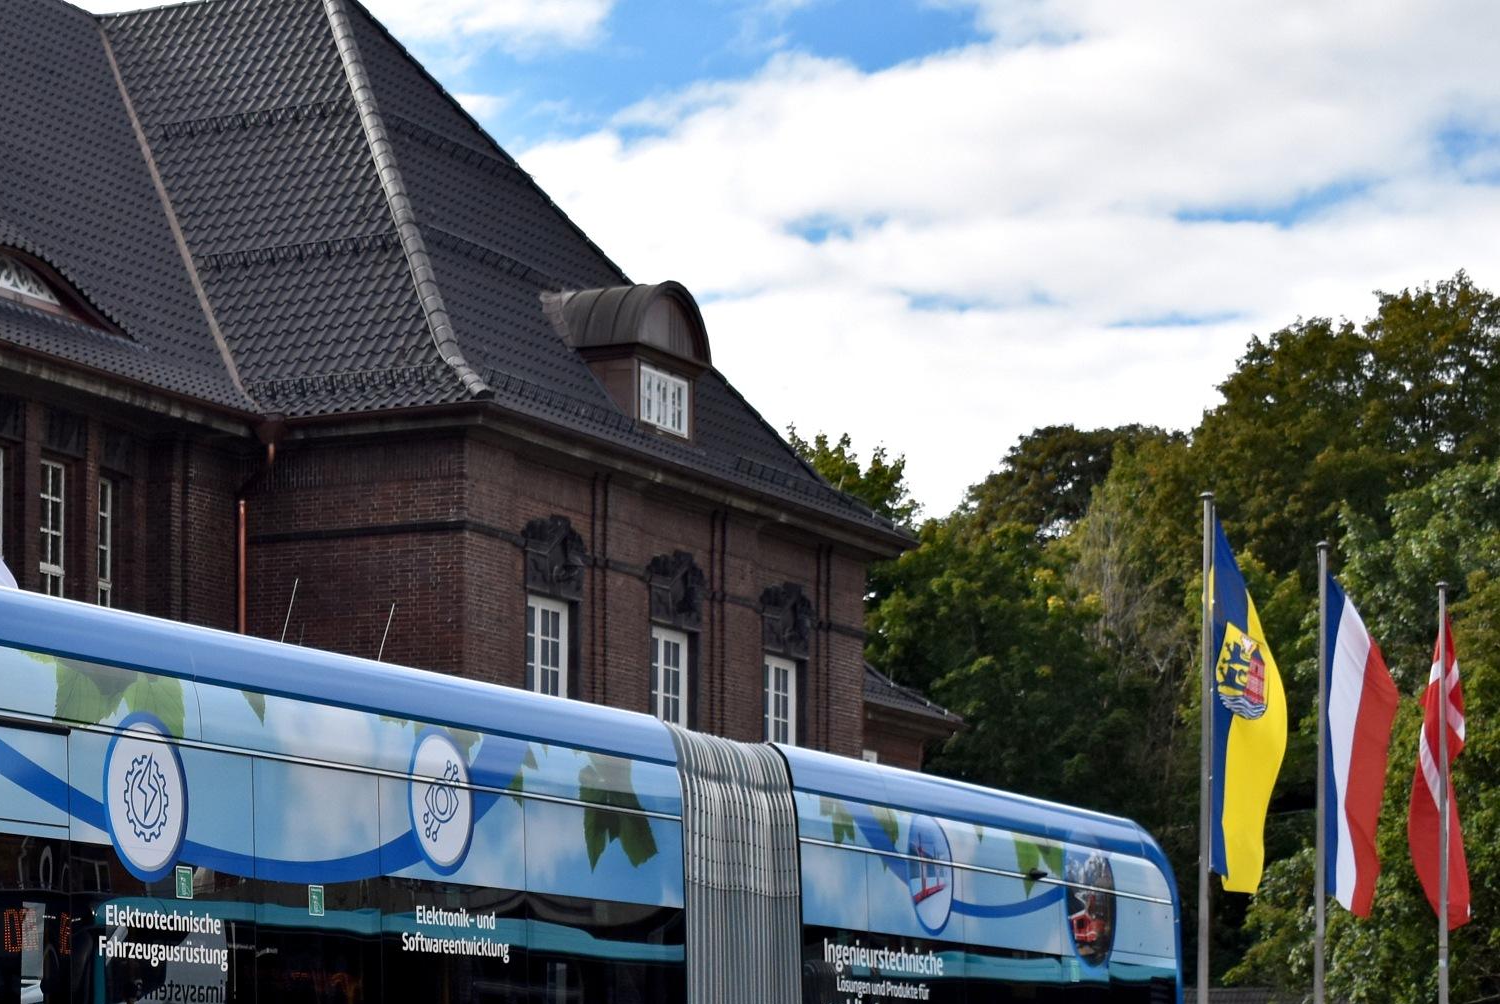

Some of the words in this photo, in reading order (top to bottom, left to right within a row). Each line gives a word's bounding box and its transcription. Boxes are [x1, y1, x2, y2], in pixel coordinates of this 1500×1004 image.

[105, 904, 221, 935] Elektrotechnische
[415, 905, 475, 928] Elektronik-
[477, 911, 496, 930] und
[98, 935, 228, 971] Fahrzeugausrüstung
[402, 931, 510, 964] Softwareentwicklung
[823, 938, 944, 976] Ingenieurstechnische
[836, 975, 871, 998] Lösungen
[871, 980, 886, 996] und
[886, 981, 918, 998] Produkte
[918, 983, 930, 1000] für
